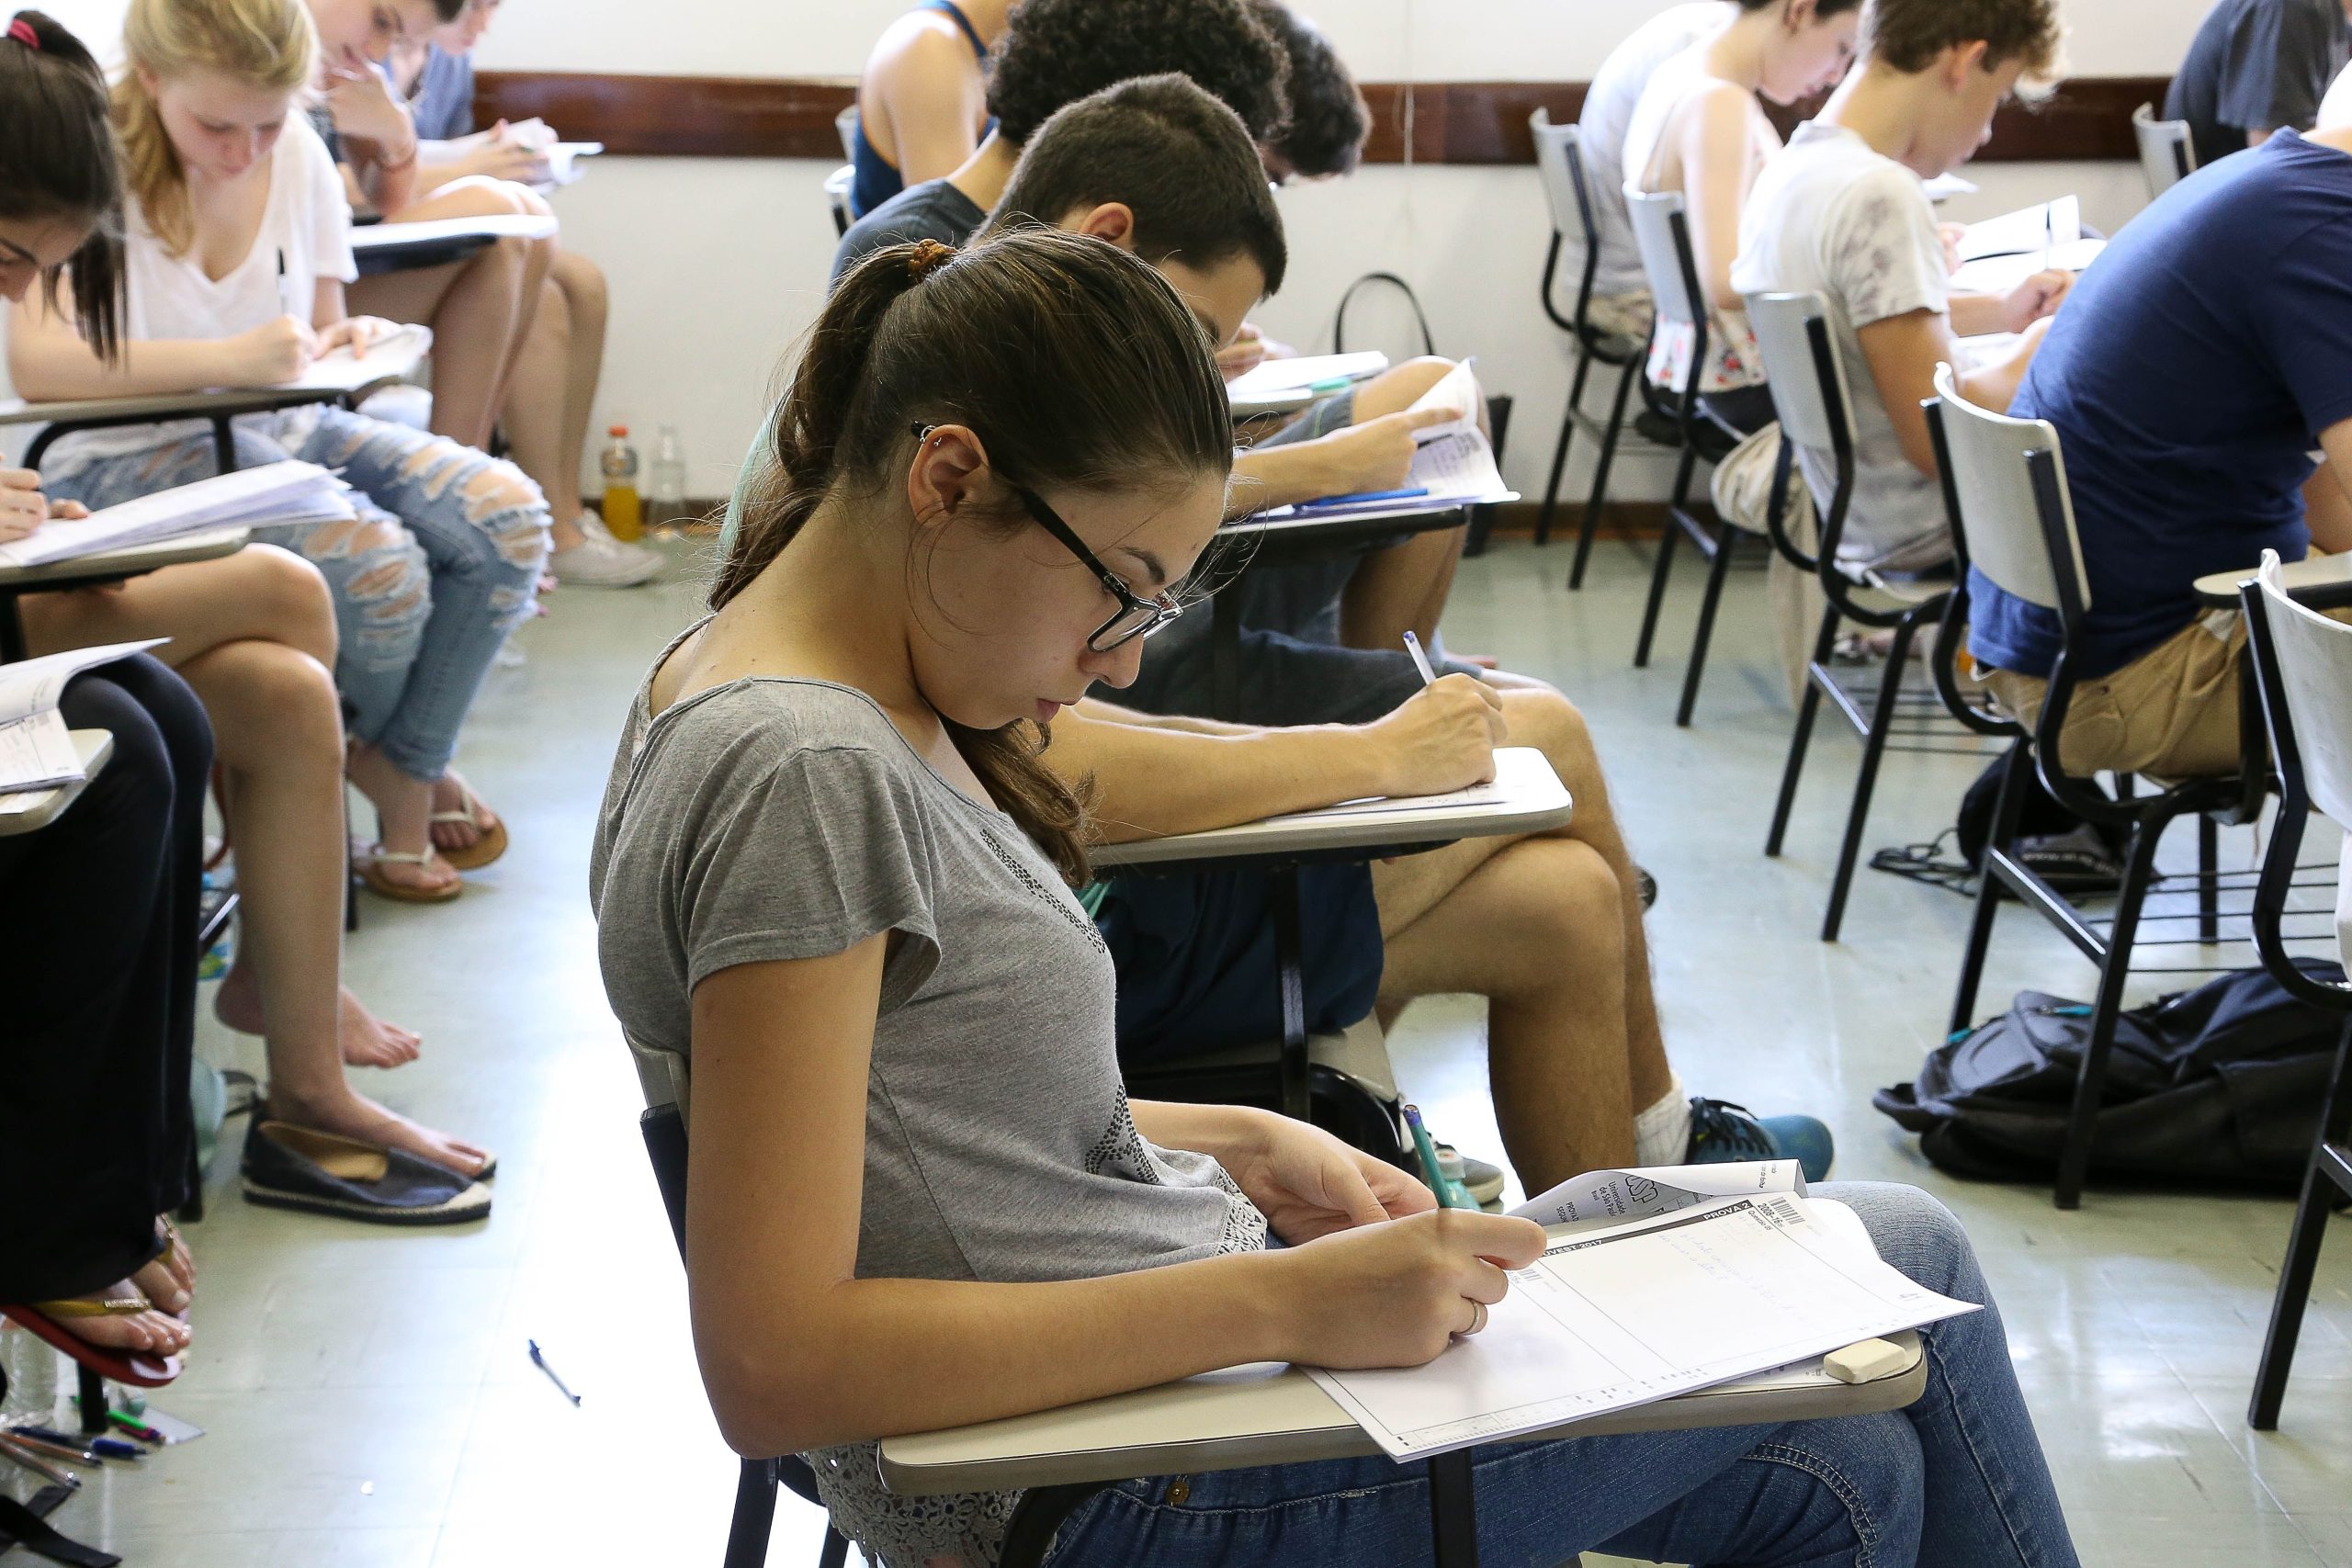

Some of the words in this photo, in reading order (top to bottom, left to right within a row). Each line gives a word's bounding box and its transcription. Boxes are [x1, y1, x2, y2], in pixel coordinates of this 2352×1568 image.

[1599, 1186, 1608, 1195] de
[1602, 1192, 1611, 1205] São
[1608, 1181, 1627, 1215] Universidade
[1556, 1205, 1569, 1223] SEGUN
[1702, 1204, 1742, 1221] PROVA
[1543, 1245, 1577, 1257] UVEST
[1578, 1239, 1603, 1248] 2017
